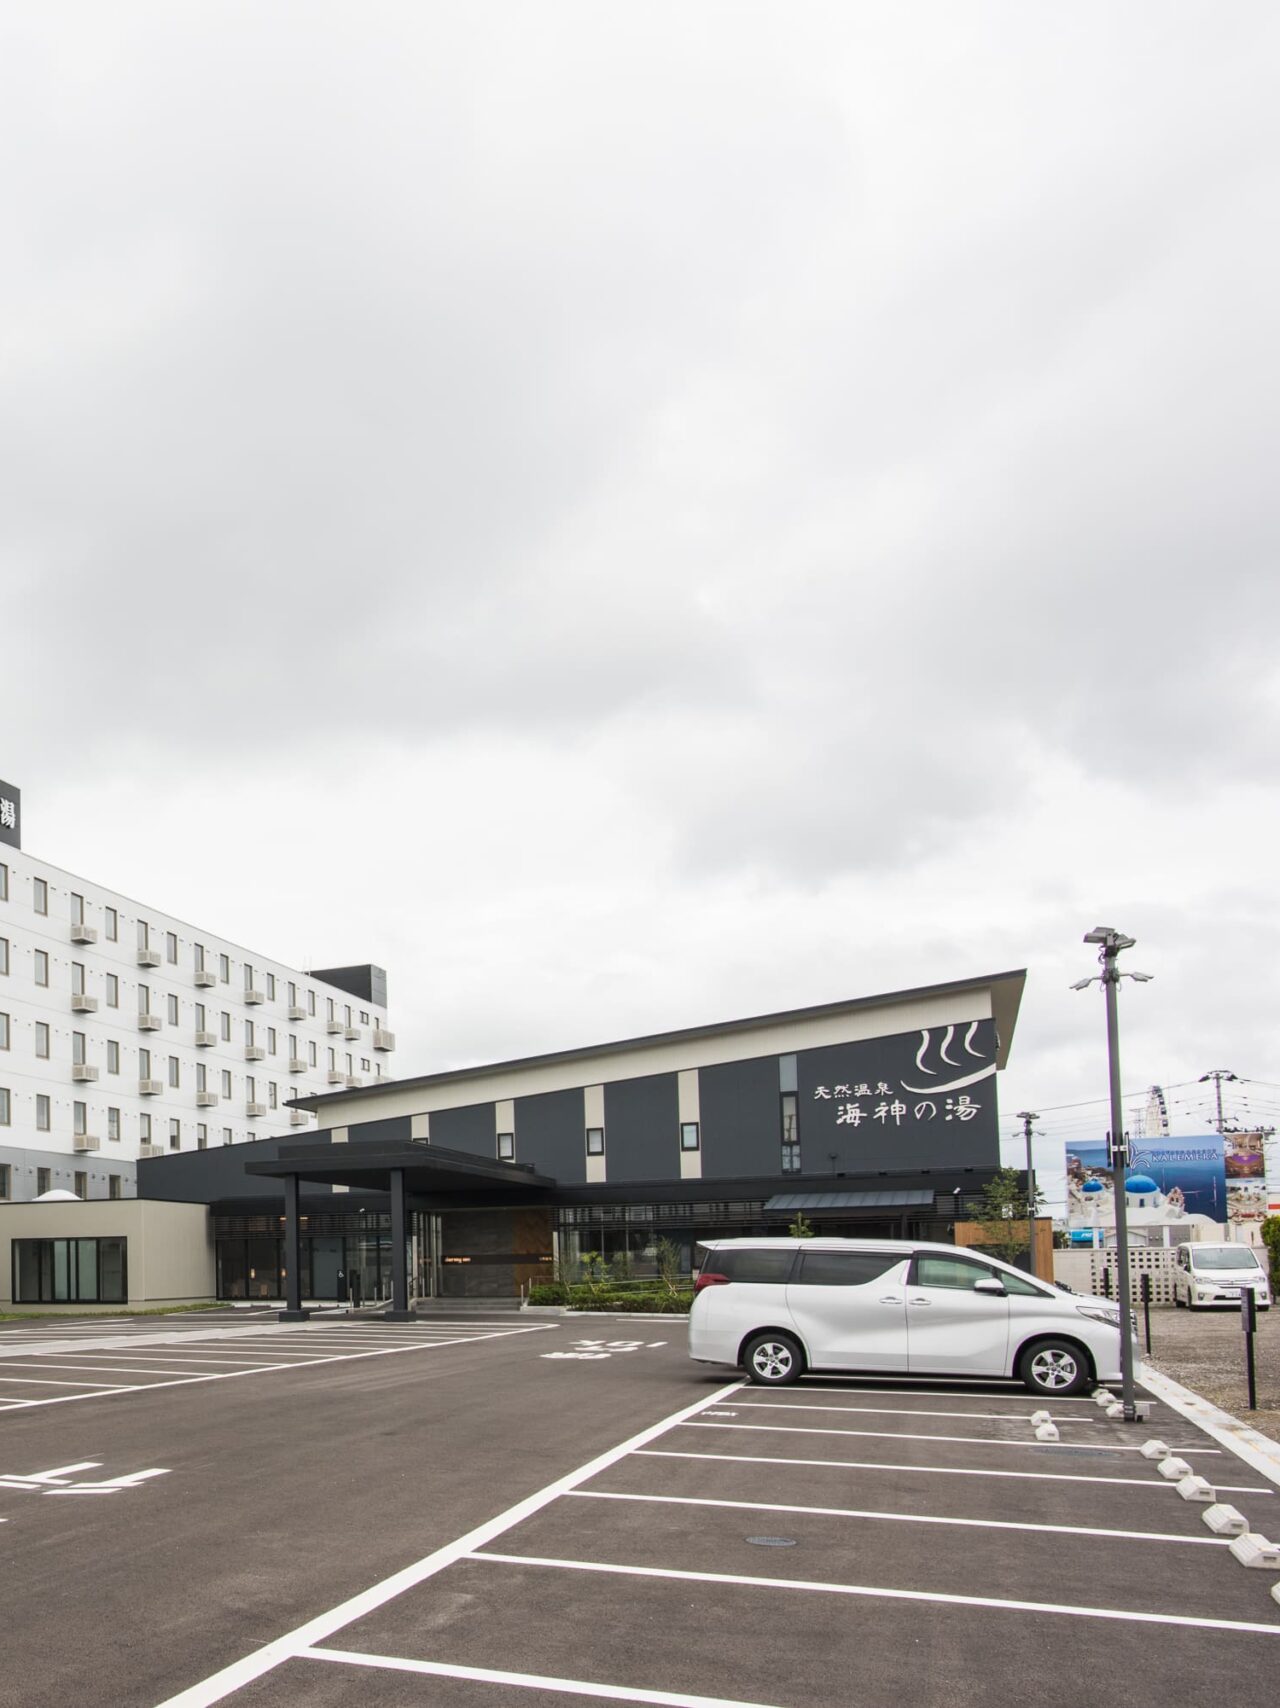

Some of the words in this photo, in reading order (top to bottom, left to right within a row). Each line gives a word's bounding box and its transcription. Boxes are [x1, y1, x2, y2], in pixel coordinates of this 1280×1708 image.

[814, 1082, 894, 1100] 天然温泉
[836, 1096, 982, 1127] 海神の湯
